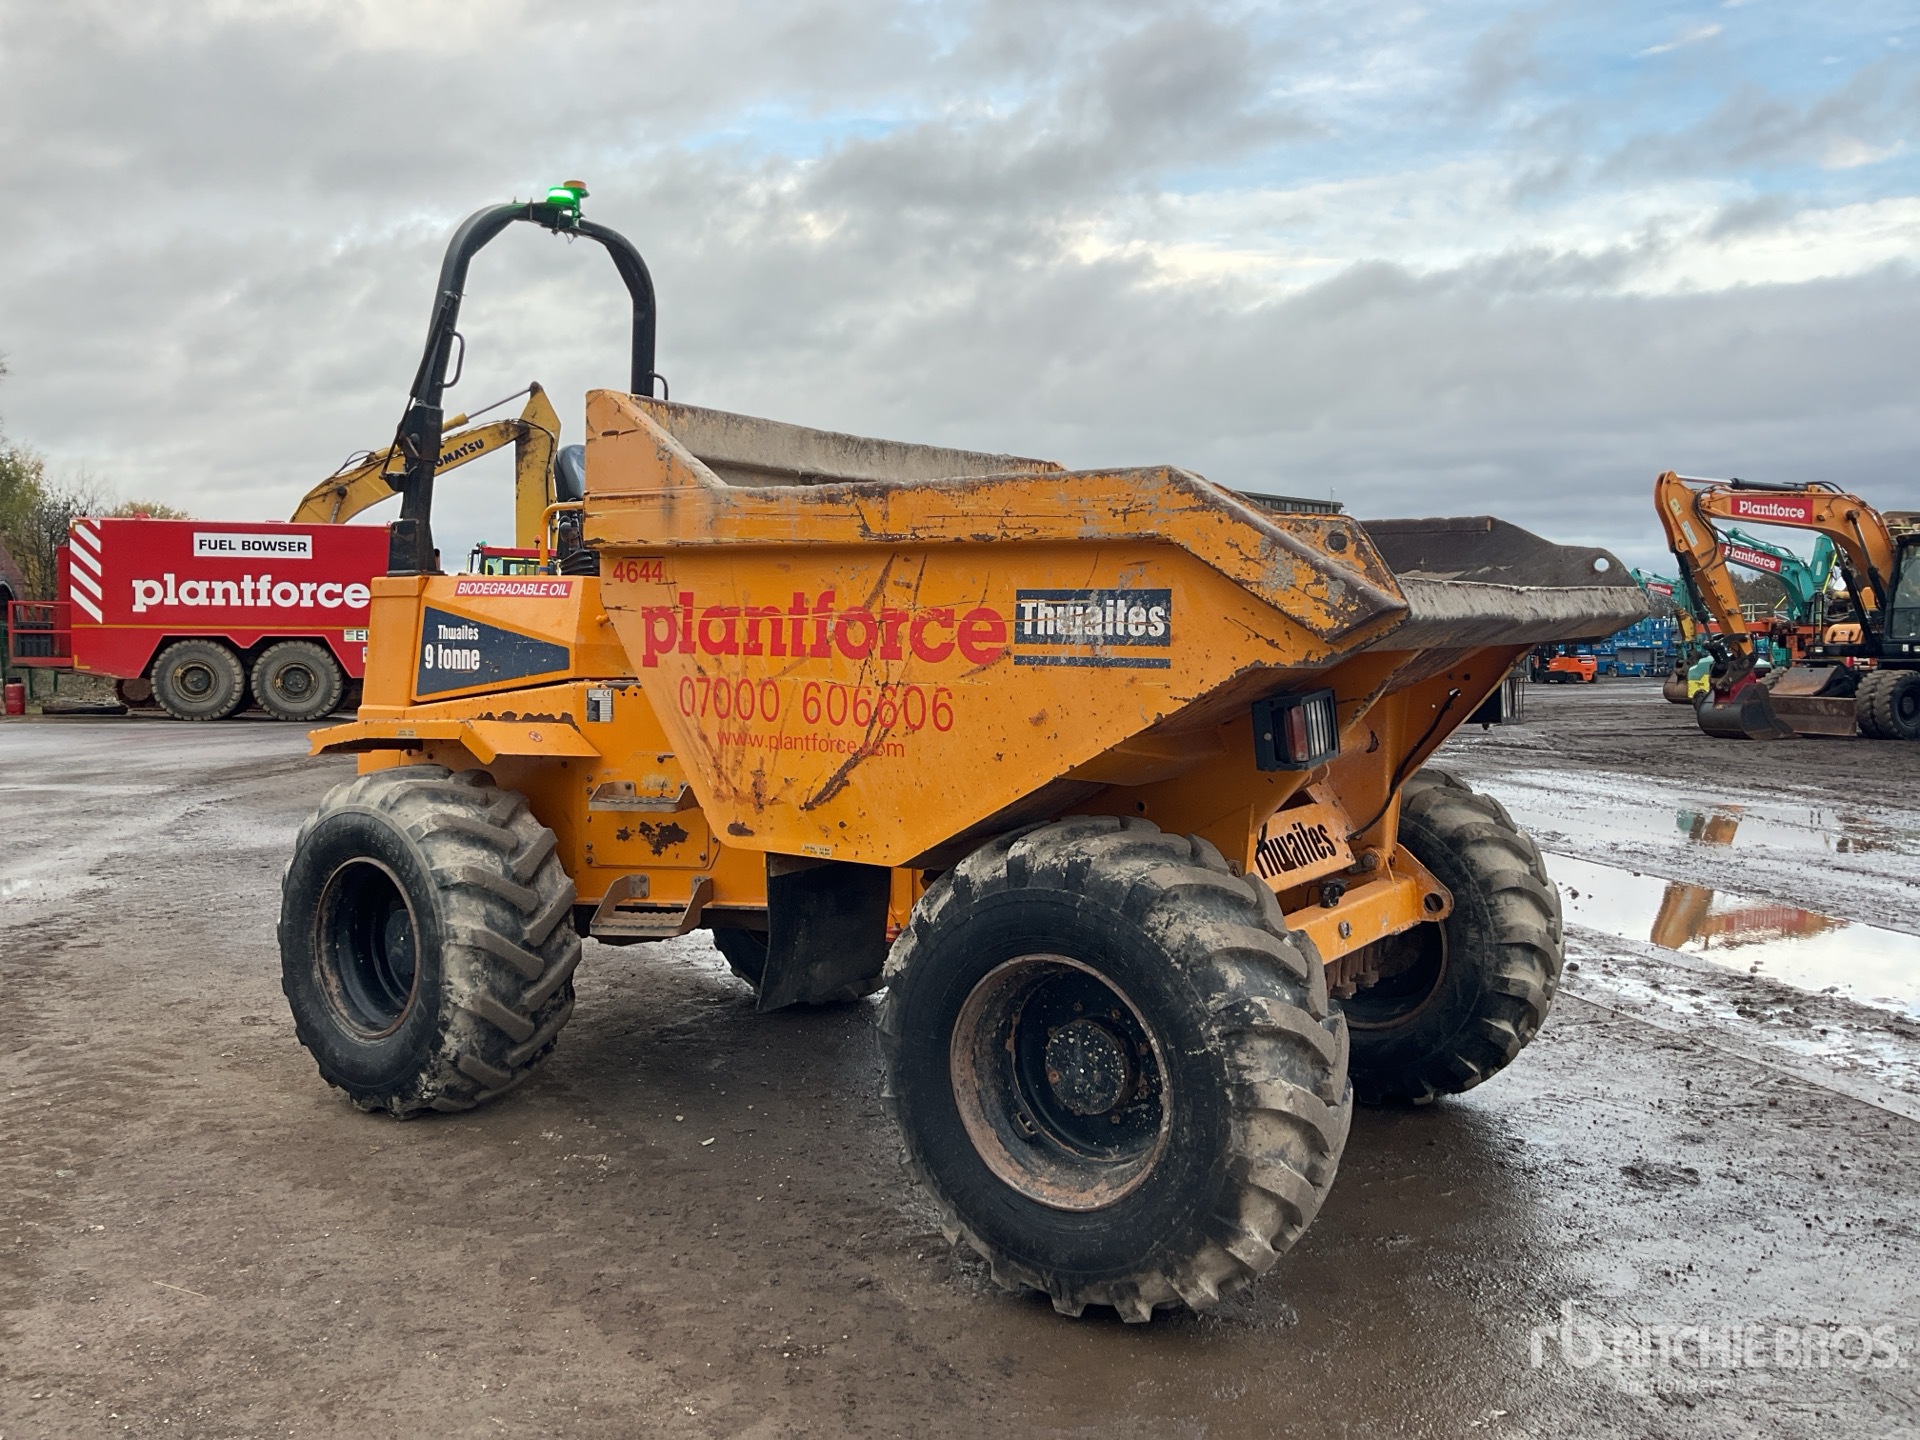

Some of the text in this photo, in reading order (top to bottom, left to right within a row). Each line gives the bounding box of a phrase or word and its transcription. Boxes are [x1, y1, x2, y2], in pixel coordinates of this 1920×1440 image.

[435, 439, 485, 469] OMATSU
[1738, 500, 1806, 519] Plantforce
[198, 538, 308, 552] FUEL BOWSER
[1723, 545, 1777, 569] Plantforce
[612, 561, 663, 583] 4644
[131, 572, 372, 613] plantforce
[457, 581, 569, 596] BIODEGRADABLE OIL
[641, 591, 1007, 668] plantforce
[1020, 599, 1166, 637] Thwaites
[437, 624, 479, 641] Thwaites
[424, 643, 480, 671] 9 tonne
[679, 675, 954, 732] 07000 606606
[717, 728, 906, 758] www.plantforce.com
